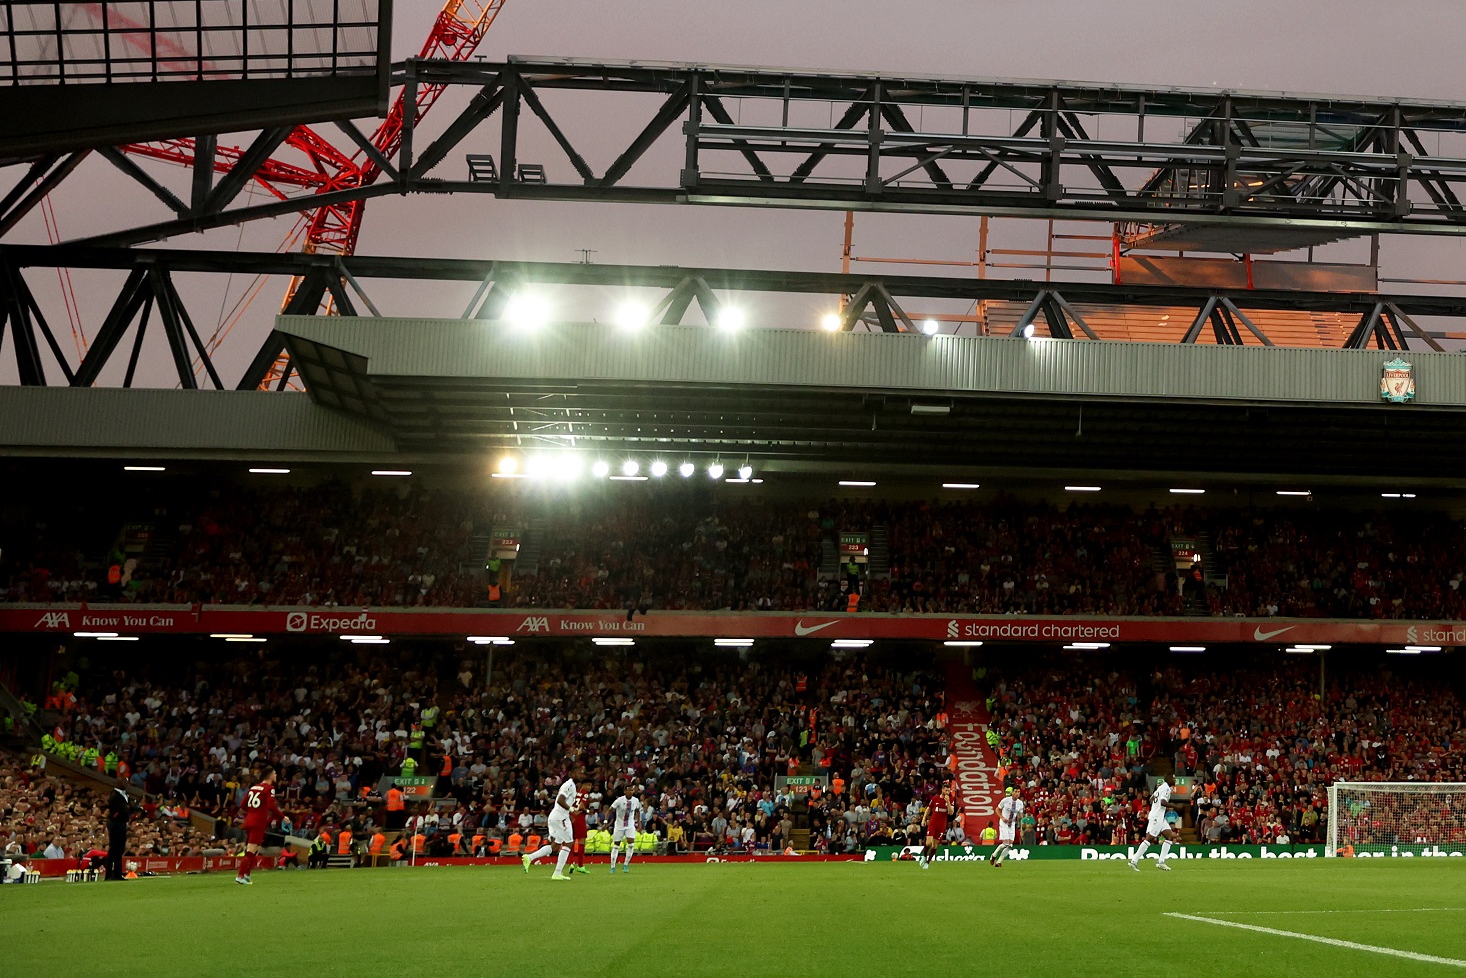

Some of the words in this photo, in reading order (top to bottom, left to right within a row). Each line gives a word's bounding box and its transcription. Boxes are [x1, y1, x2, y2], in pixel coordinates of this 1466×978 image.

[34, 612, 70, 628] AXA
[82, 615, 118, 626] Know
[123, 616, 147, 626] You
[150, 616, 174, 627] Can
[516, 616, 550, 632] AXA
[560, 620, 594, 630] Know
[598, 620, 620, 631] You
[622, 621, 645, 631] Can
[964, 623, 1039, 637] standard
[1042, 624, 1120, 638] chartered
[953, 723, 1002, 817] Foundation
[786, 777, 804, 785] EXIT
[247, 790, 261, 809] 26
